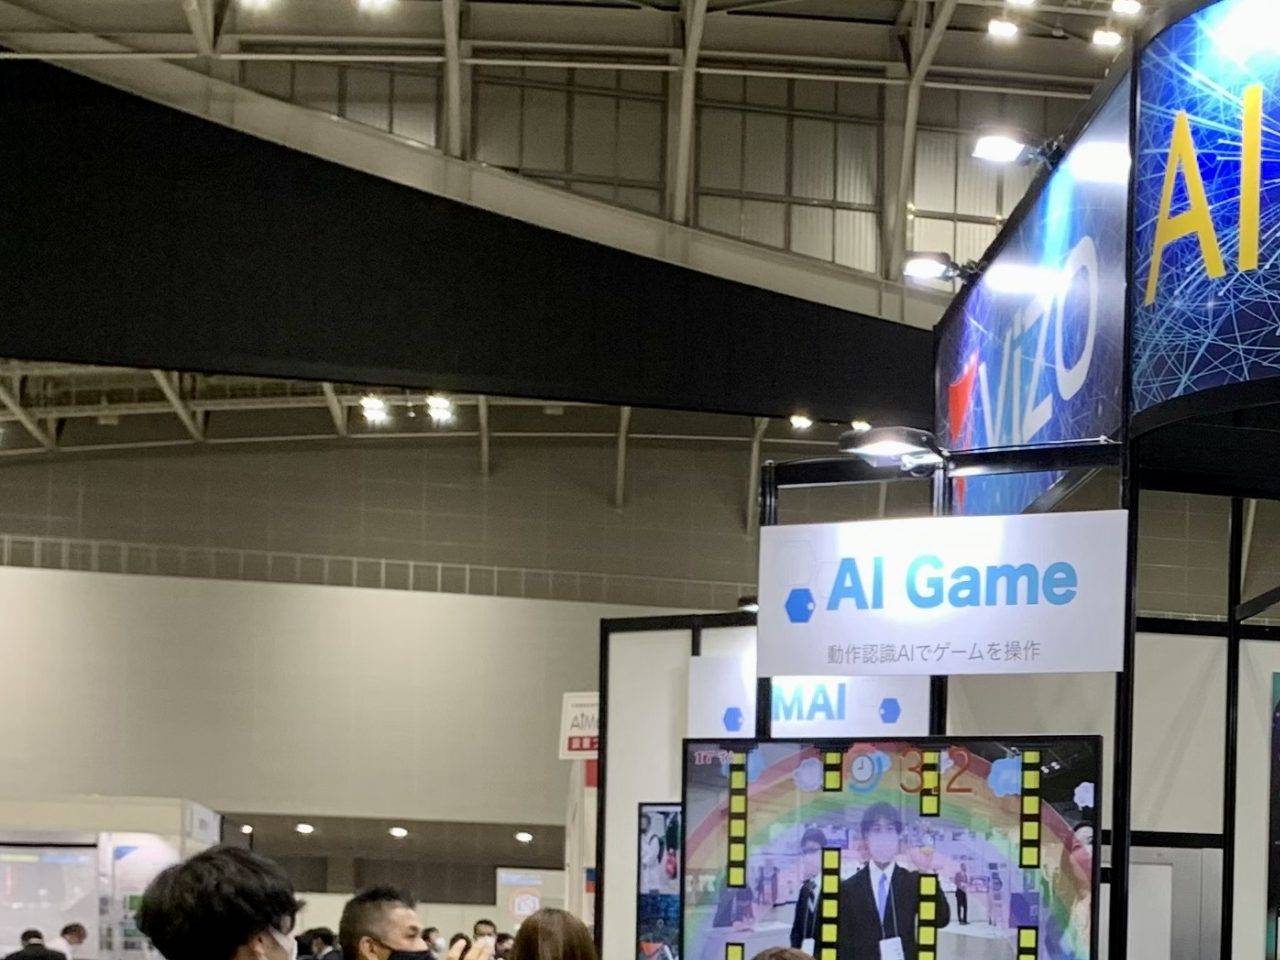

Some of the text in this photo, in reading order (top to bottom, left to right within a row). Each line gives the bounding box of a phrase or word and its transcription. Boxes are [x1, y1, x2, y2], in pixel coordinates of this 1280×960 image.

[1143, 84, 1265, 306] AI
[827, 554, 1078, 611] AI Game
[827, 640, 1041, 665] 動作認識AIでゲームを操作
